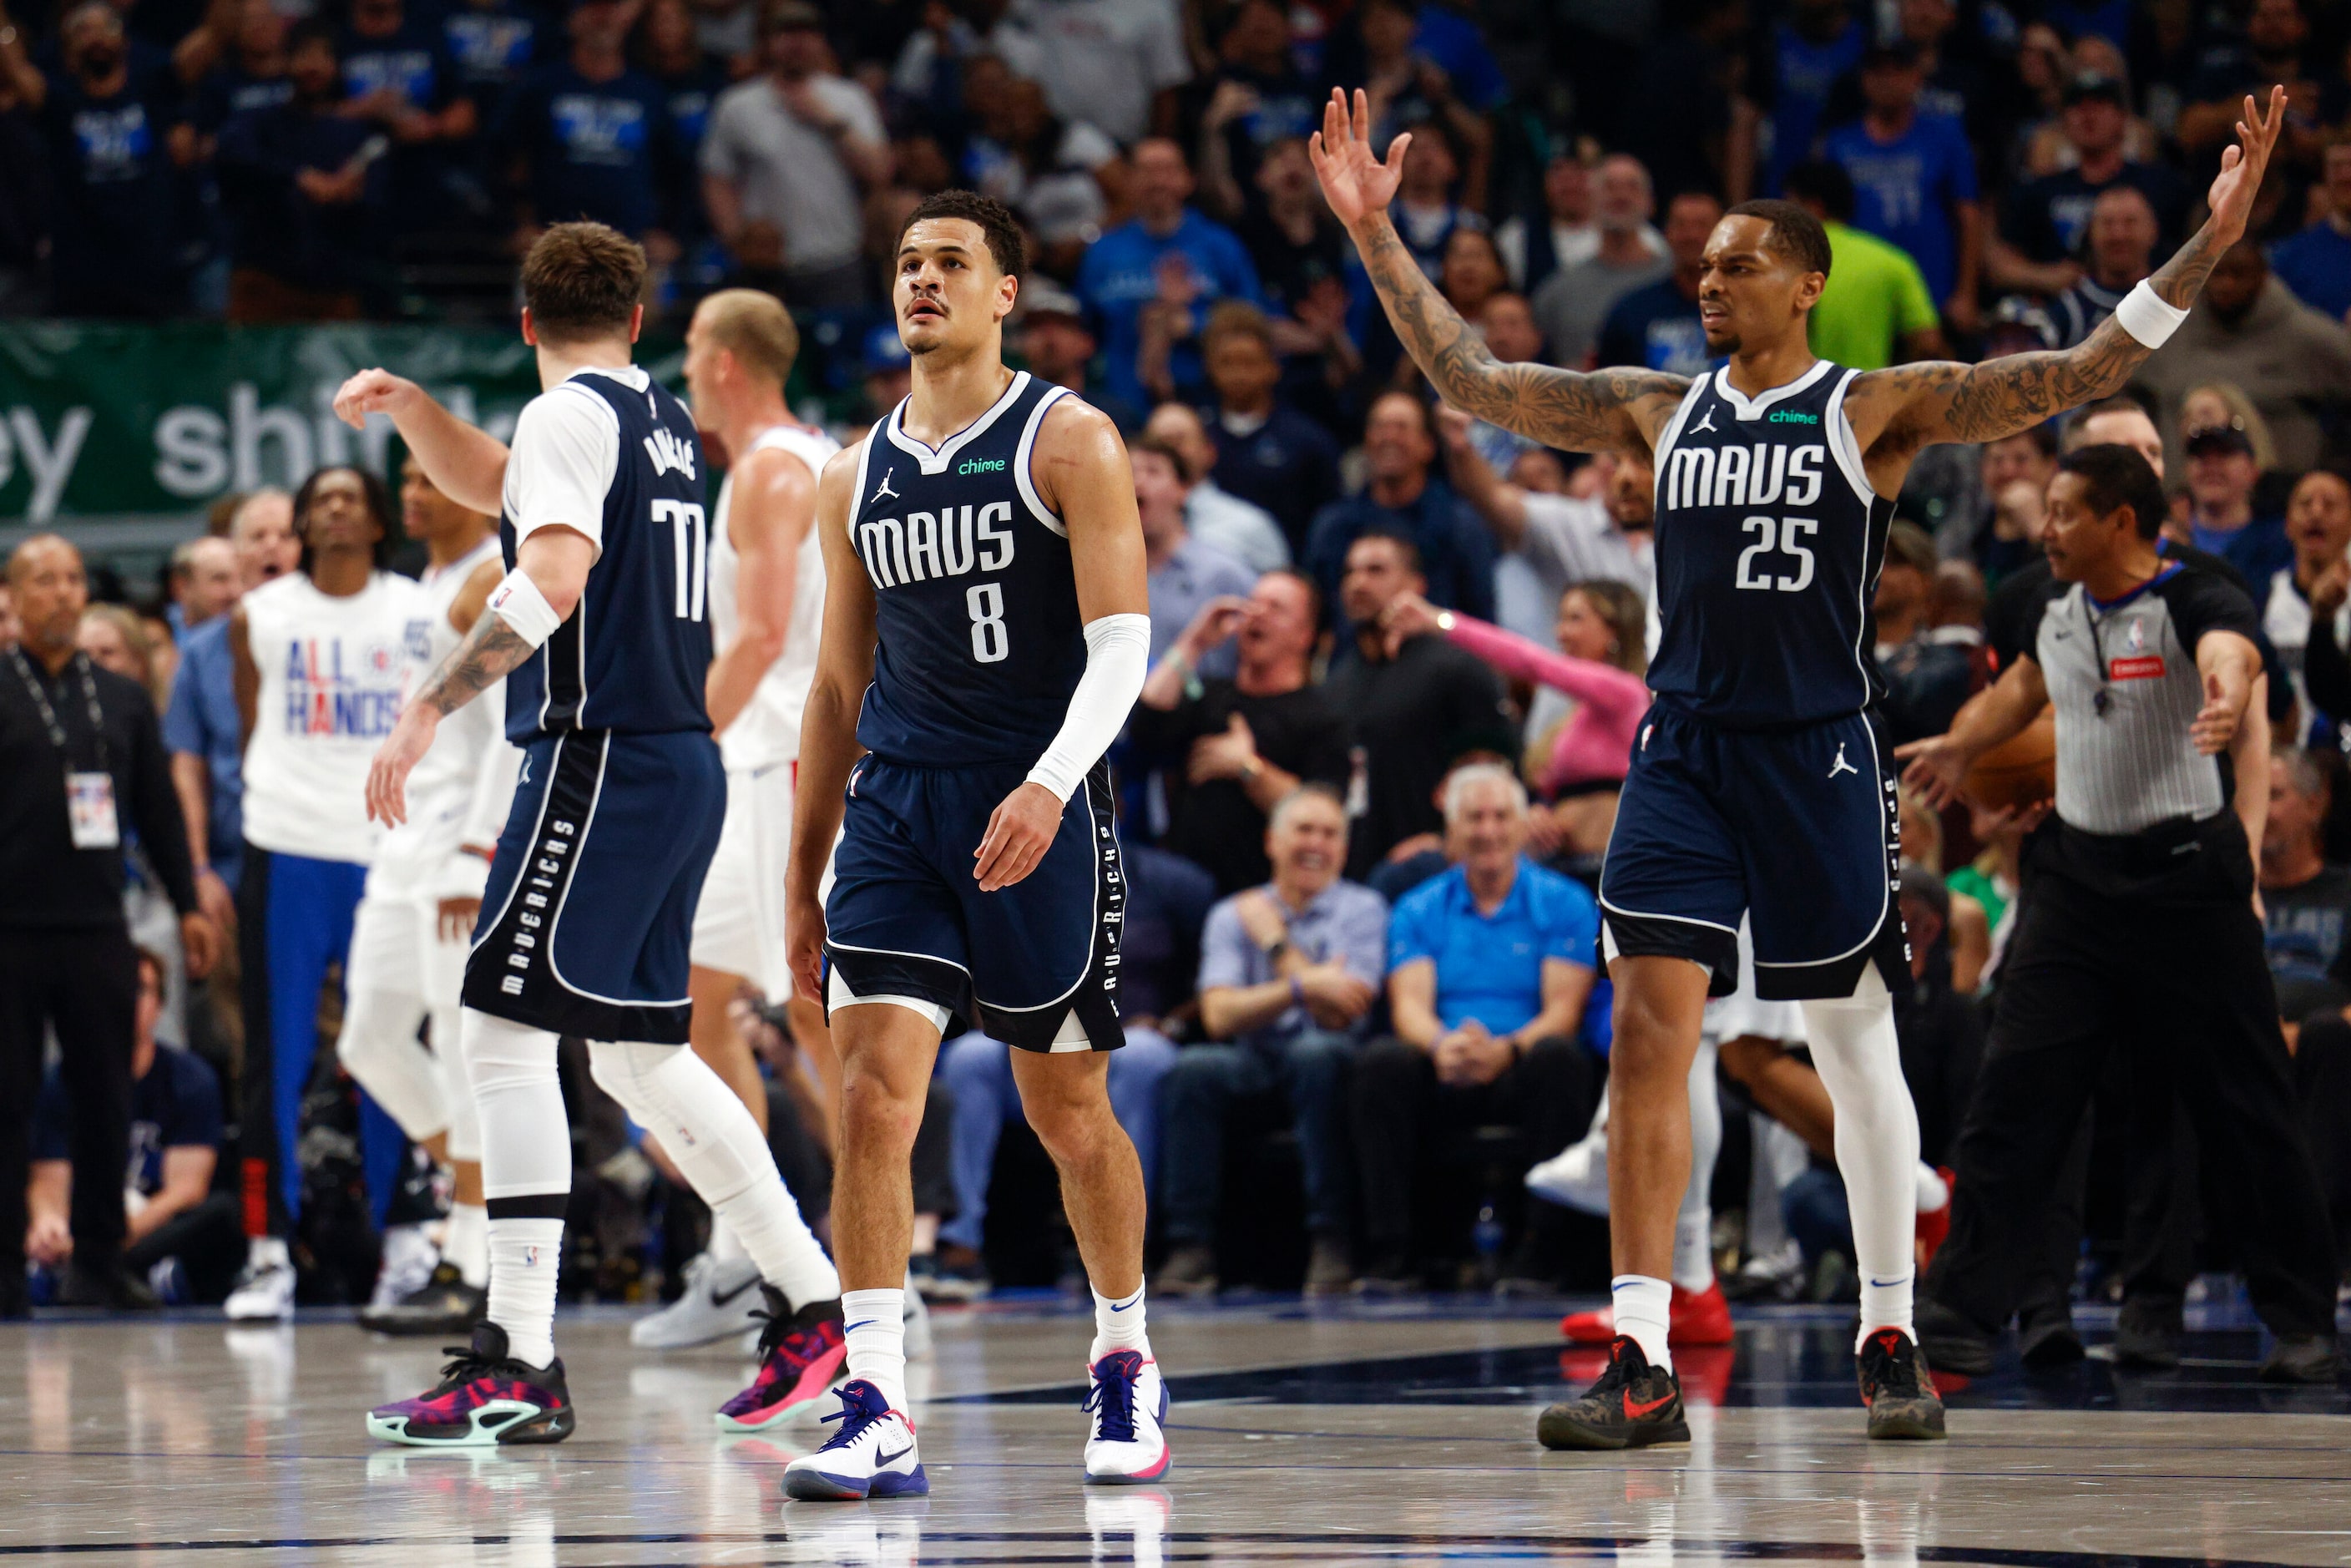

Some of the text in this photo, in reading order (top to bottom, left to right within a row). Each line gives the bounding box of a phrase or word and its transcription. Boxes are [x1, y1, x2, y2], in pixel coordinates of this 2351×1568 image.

[1769, 410, 1818, 424] chime
[0, 402, 94, 524] y
[958, 458, 1005, 475] chime
[1667, 443, 1825, 510] MAVS
[651, 498, 706, 623] 77
[859, 501, 1015, 589] MAVS
[1736, 516, 1818, 592] 25
[966, 582, 1009, 663] 8
[286, 637, 357, 686] ALL
